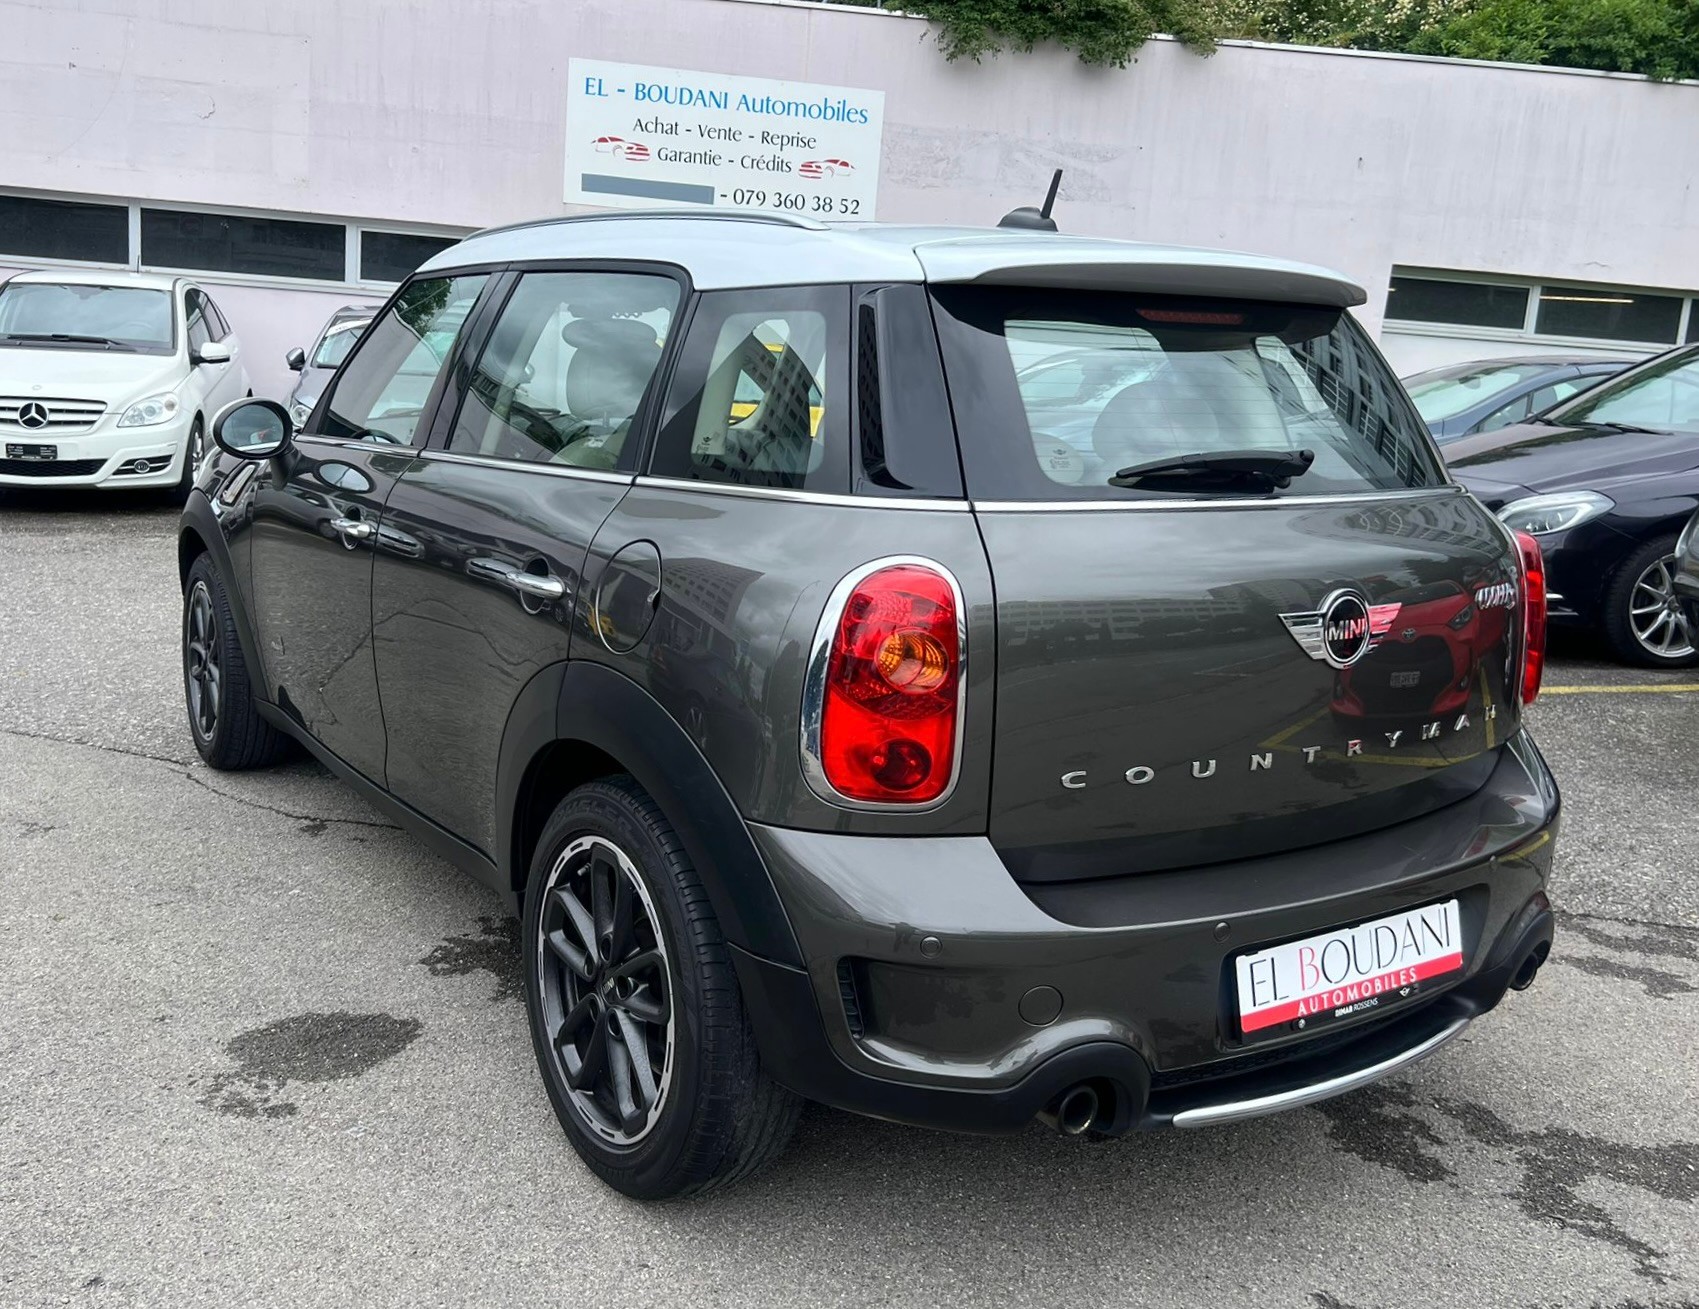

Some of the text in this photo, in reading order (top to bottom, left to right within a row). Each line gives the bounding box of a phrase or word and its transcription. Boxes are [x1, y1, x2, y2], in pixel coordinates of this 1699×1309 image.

[585, 77, 609, 97] EL
[634, 82, 728, 109] BOUDANI
[736, 94, 868, 124] Automobiles
[632, 116, 679, 136] Achat
[698, 124, 742, 142] Vente
[761, 130, 817, 152] Reprise
[657, 146, 722, 166] Garantie
[740, 154, 792, 173] Crédits
[733, 188, 766, 206] 079
[773, 192, 805, 210] 360
[811, 195, 833, 213] 38
[839, 199, 860, 215] 52
[1328, 618, 1365, 641] MINI
[1061, 704, 1496, 789] COUNTRYMAN
[1250, 907, 1450, 1007] EL BOUDANI
[1298, 968, 1418, 1017] AUTOMOBILES
